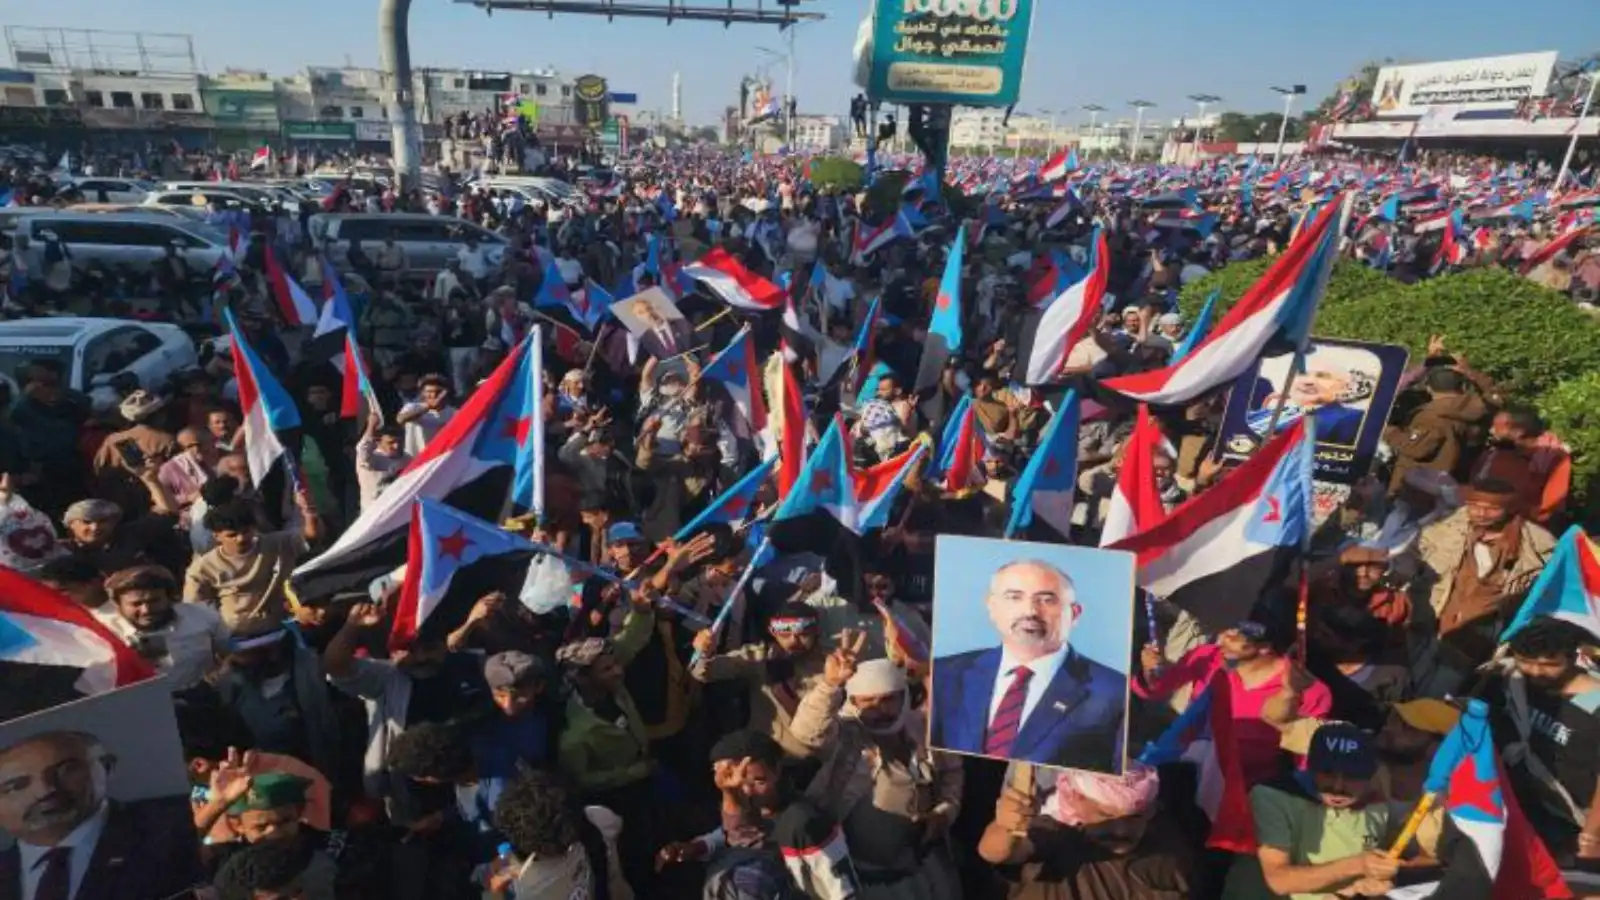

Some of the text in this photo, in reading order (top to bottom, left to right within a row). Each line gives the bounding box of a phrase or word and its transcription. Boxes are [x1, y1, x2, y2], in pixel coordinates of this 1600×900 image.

[940, 24, 961, 39] في
[893, 36, 937, 54] جوال
[1325, 735, 1358, 753] VIP
